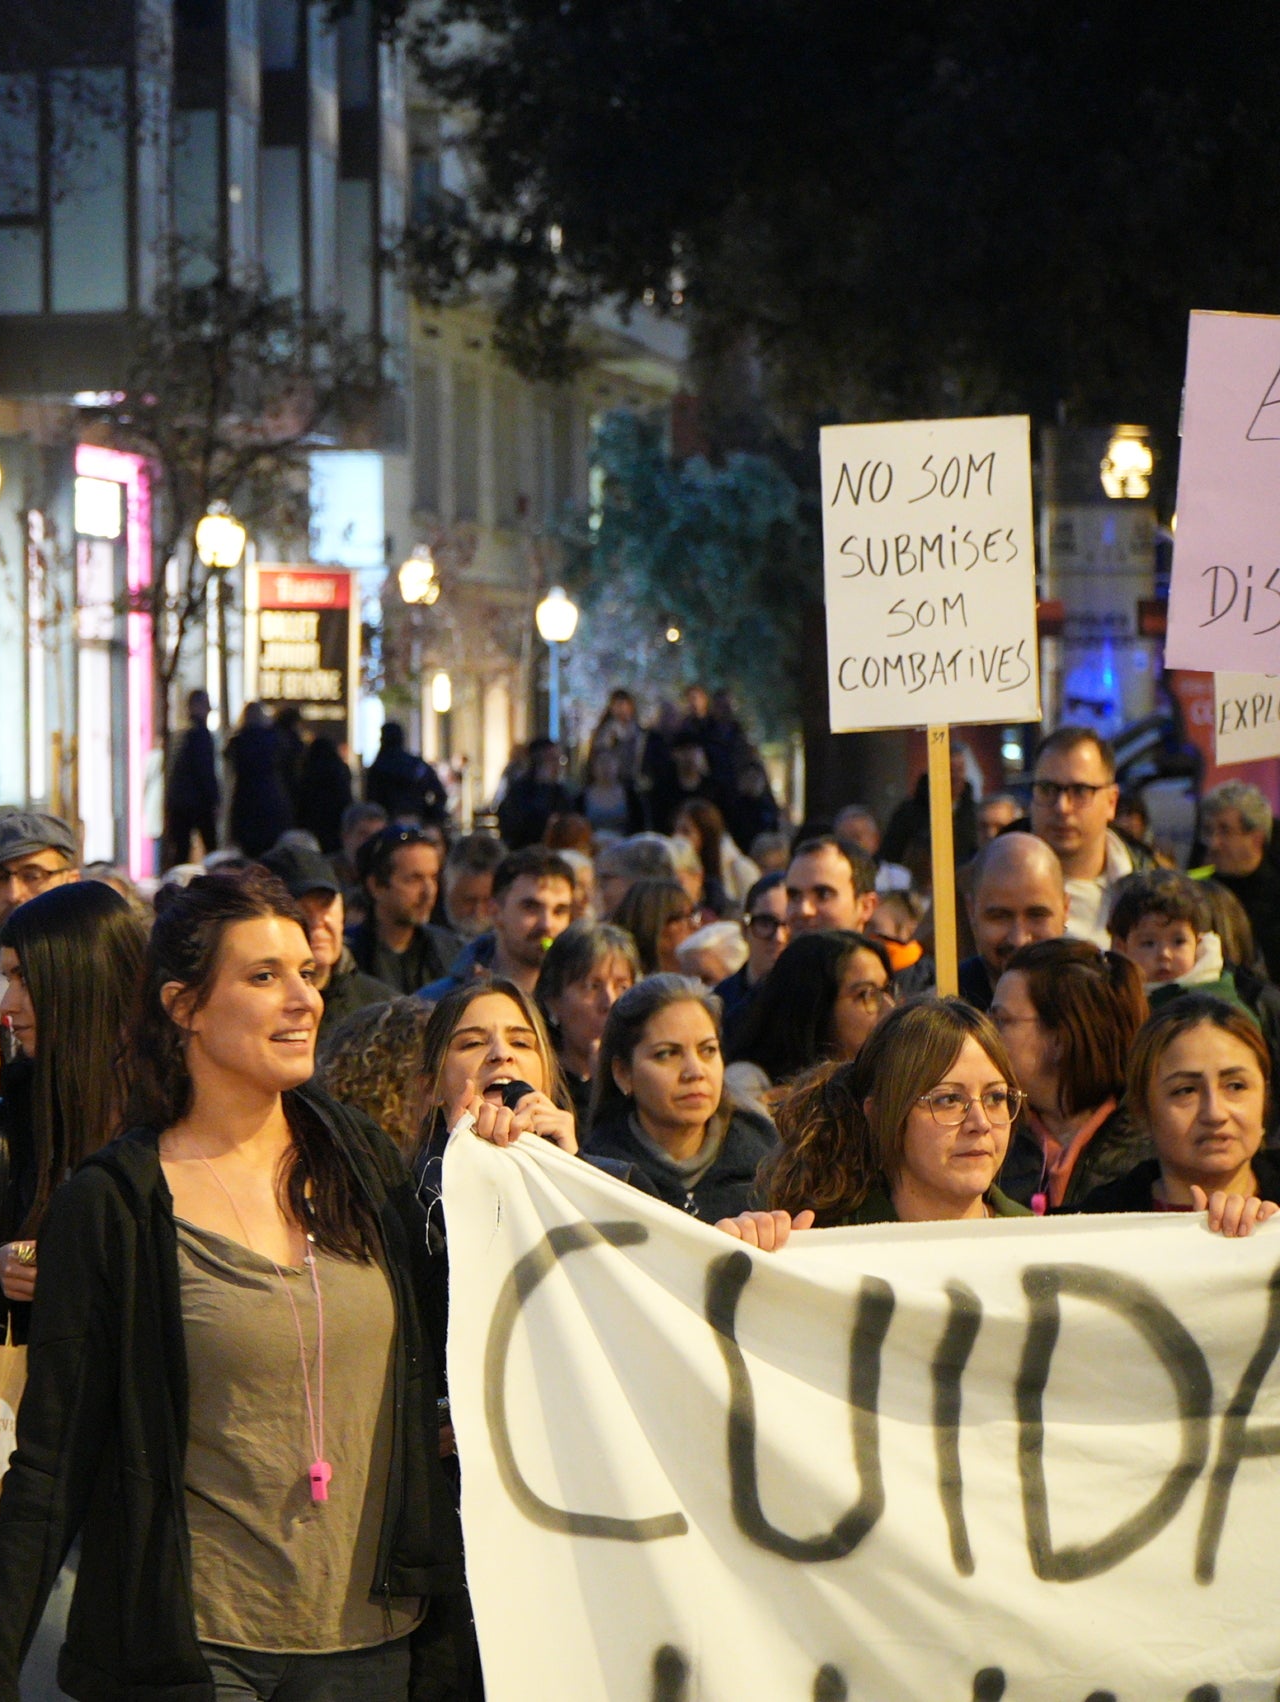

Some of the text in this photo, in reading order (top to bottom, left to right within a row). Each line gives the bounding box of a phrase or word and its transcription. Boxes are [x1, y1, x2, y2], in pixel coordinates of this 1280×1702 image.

[831, 452, 995, 507] NO SOM
[886, 593, 968, 637] SOM
[1219, 692, 1280, 735] EXPL
